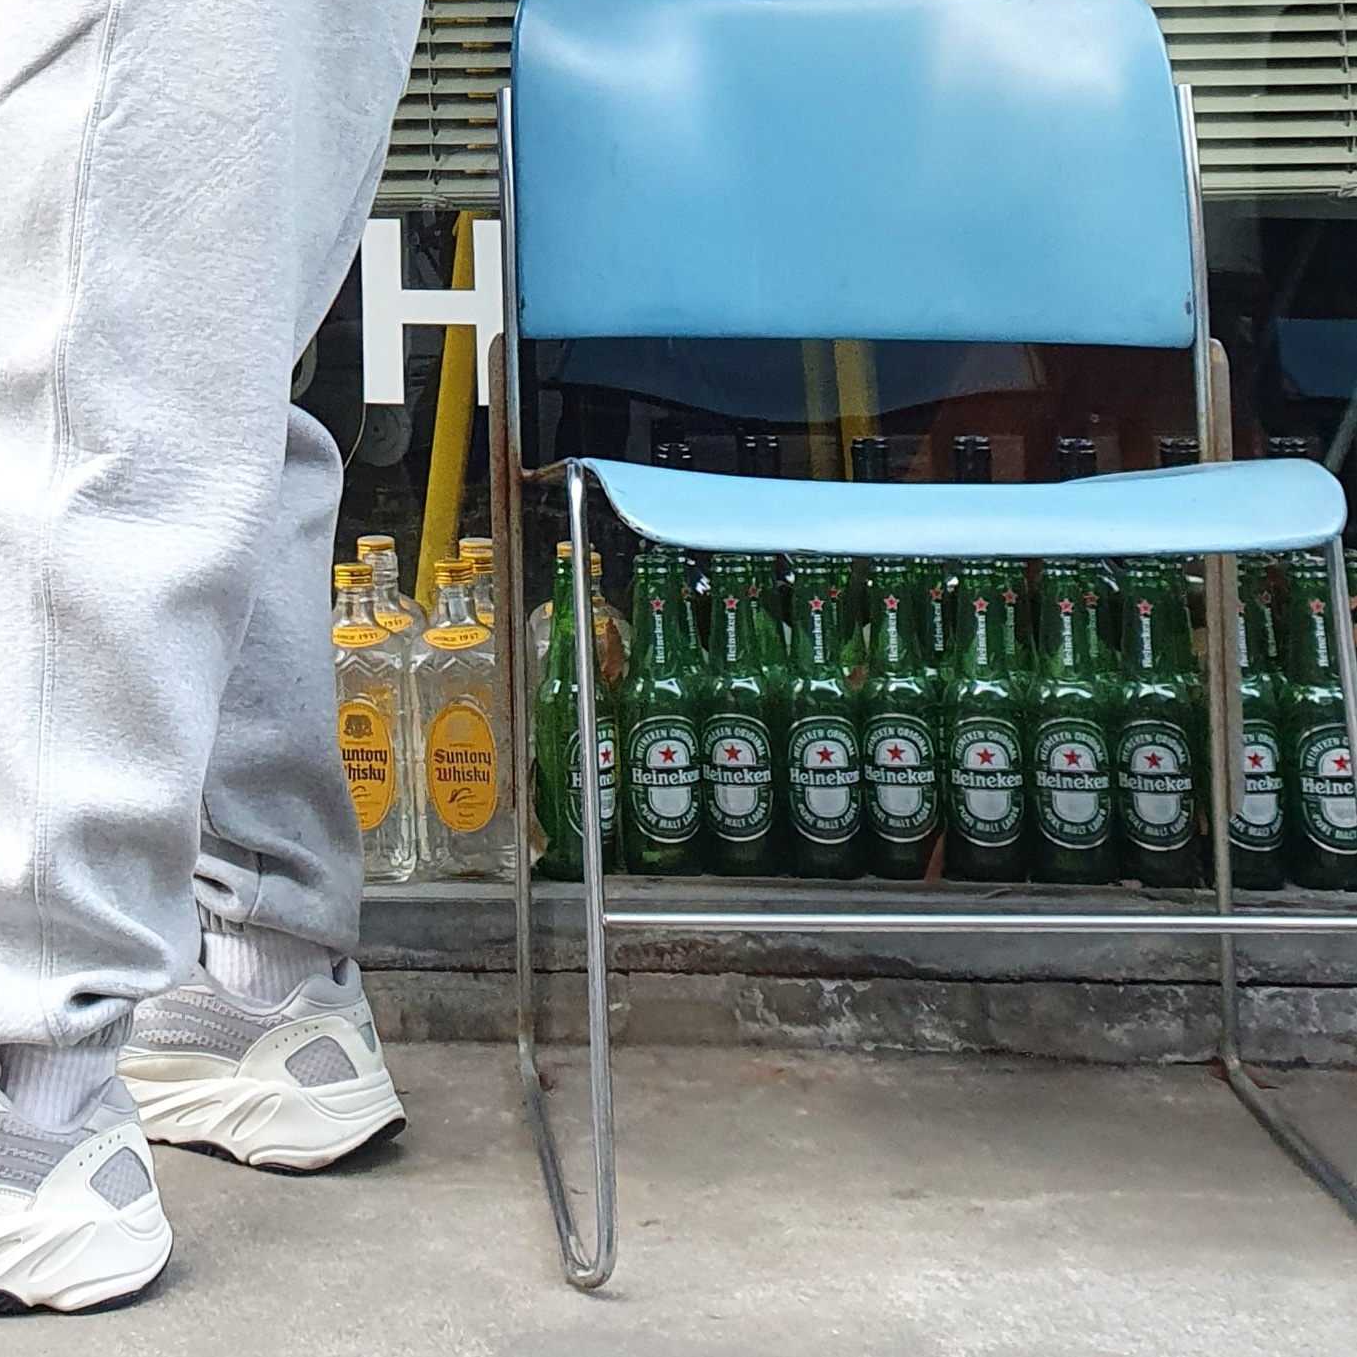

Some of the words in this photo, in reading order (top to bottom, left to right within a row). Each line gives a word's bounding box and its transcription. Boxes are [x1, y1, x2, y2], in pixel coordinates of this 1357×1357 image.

[360, 218, 504, 407] H
[341, 747, 388, 765] untory
[433, 747, 492, 766] Suntory
[347, 763, 386, 785] hisky
[435, 765, 490, 786] Whisky
[631, 767, 701, 785] Heineken
[703, 763, 772, 784] Heineken
[789, 767, 861, 785] Heineken
[864, 764, 936, 785] Heineken
[951, 768, 1024, 789] Heineken
[1036, 770, 1111, 790] Heineken
[1118, 770, 1193, 792] Heineken
[1302, 776, 1355, 795] Heine
